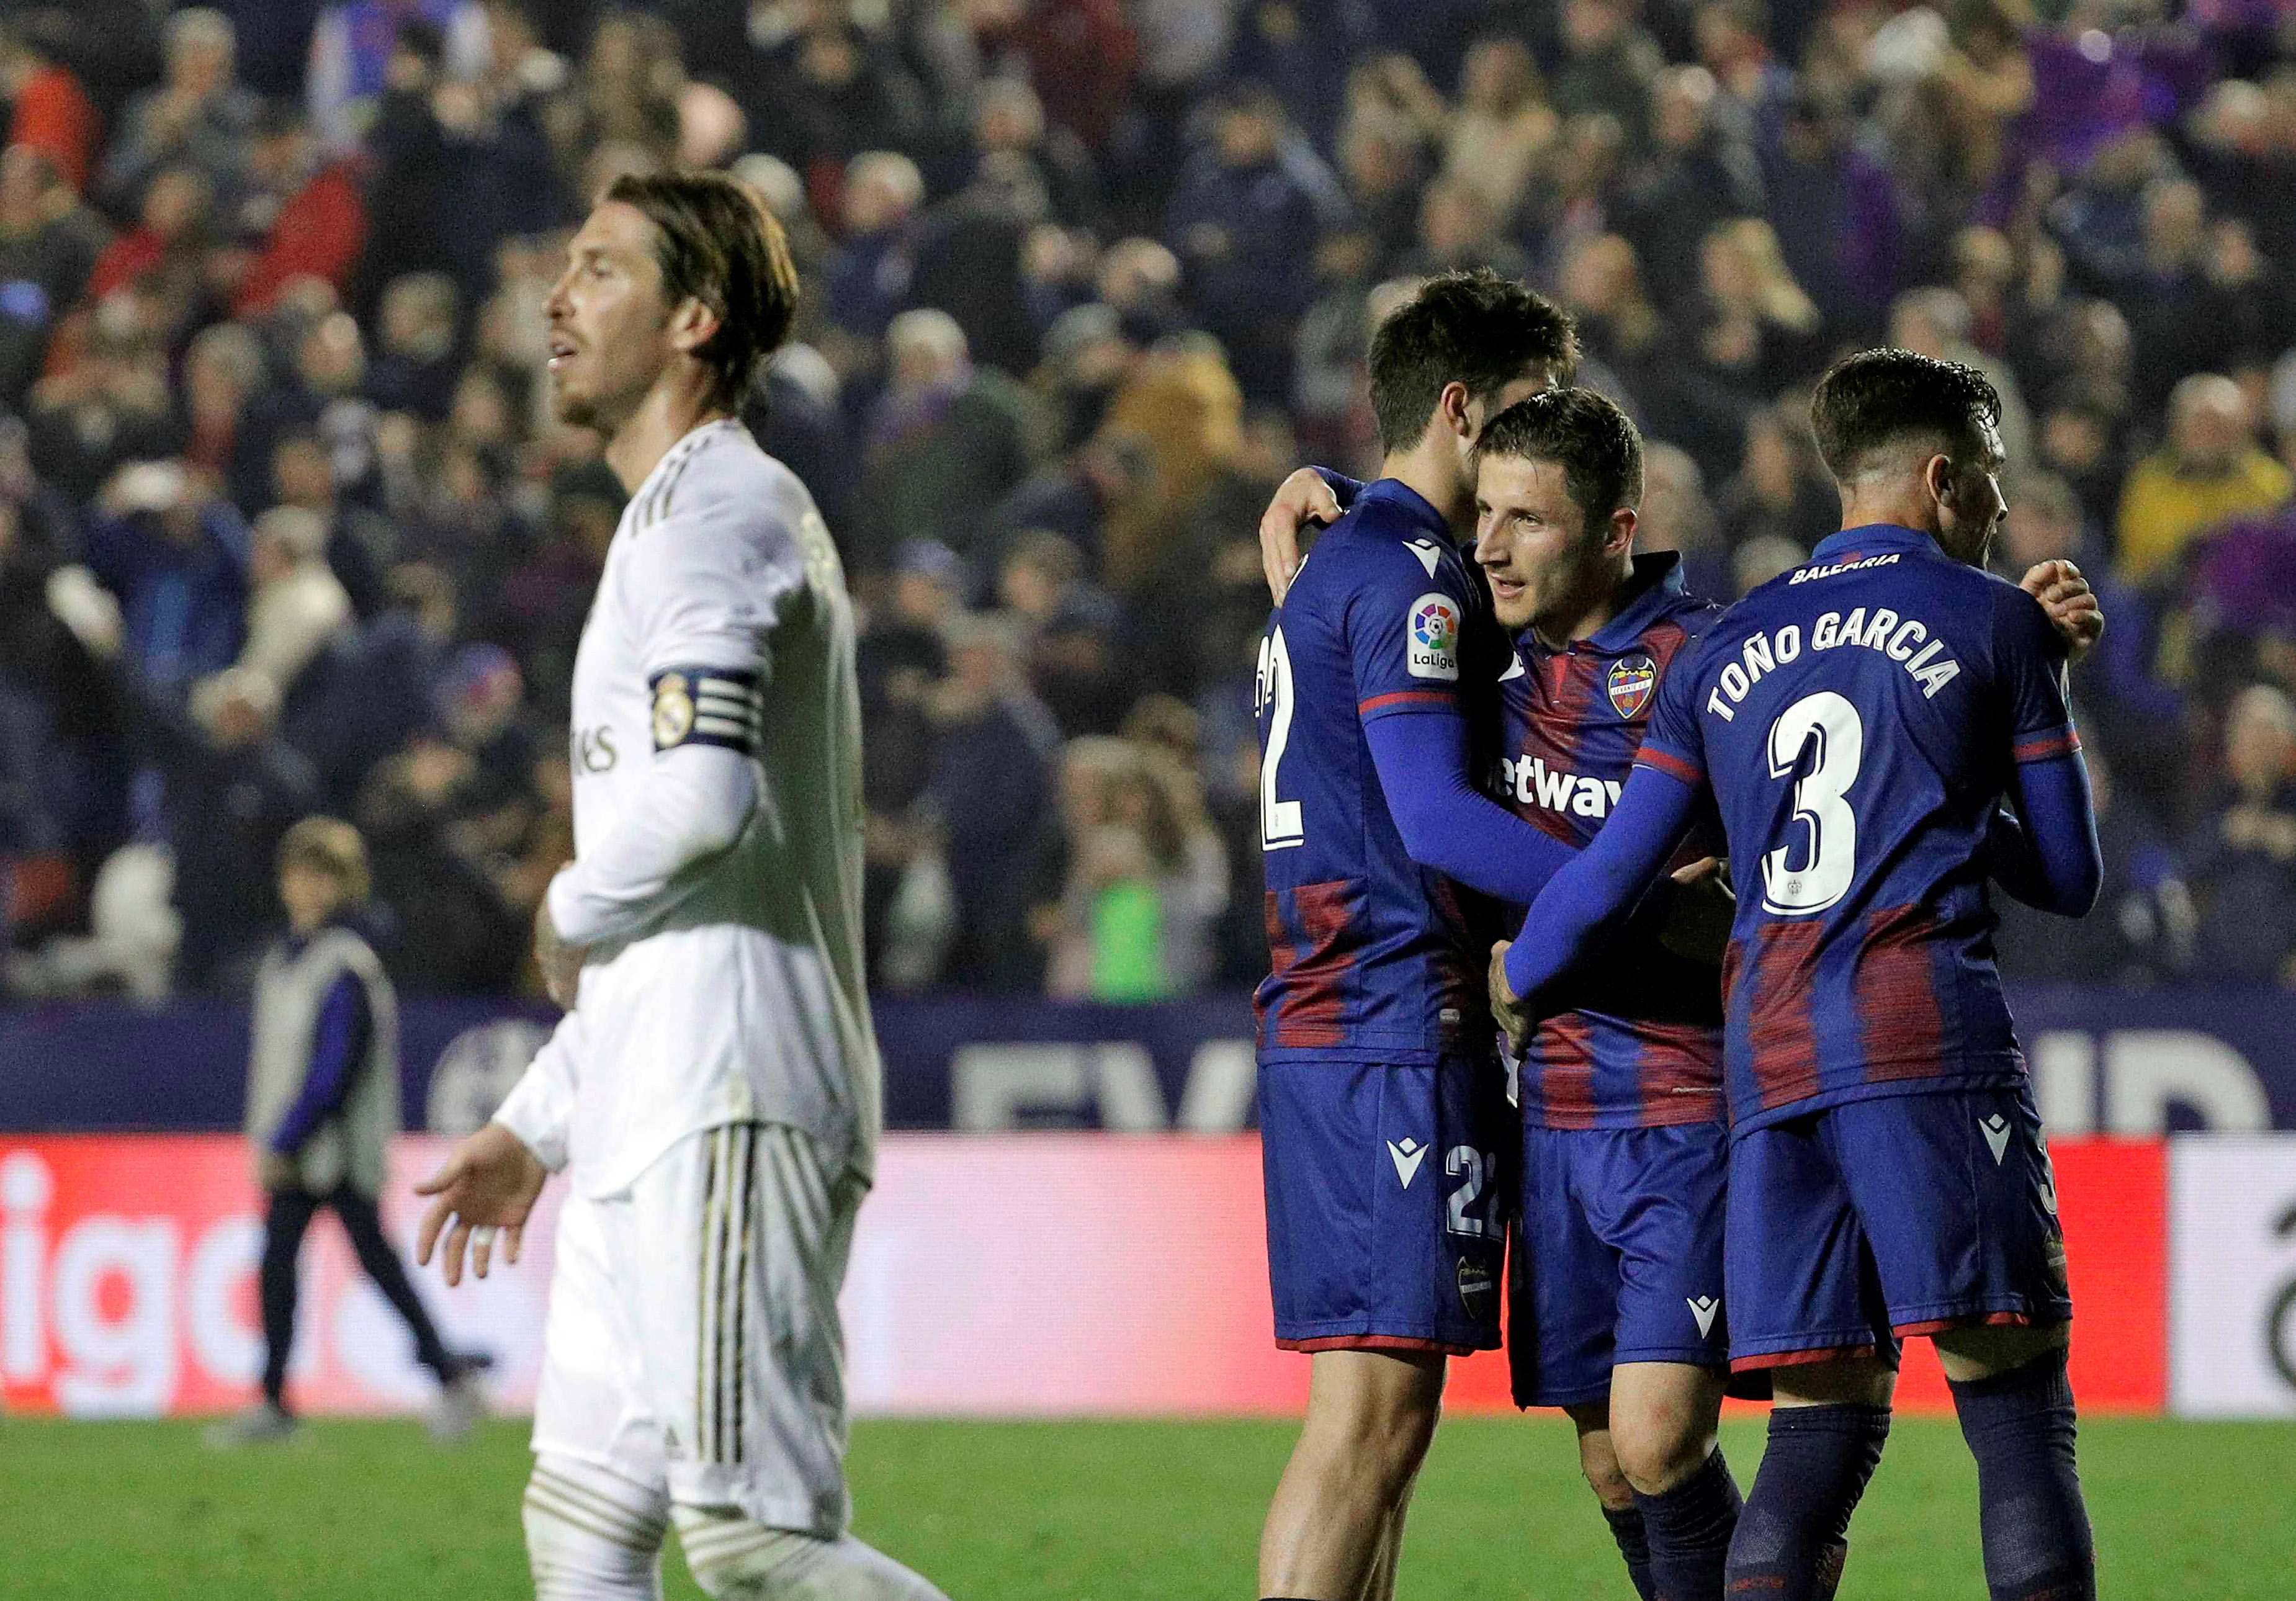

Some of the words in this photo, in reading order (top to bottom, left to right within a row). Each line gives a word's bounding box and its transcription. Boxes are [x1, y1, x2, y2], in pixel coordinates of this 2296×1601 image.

[1414, 652, 1455, 670] LaLiga
[1706, 624, 1800, 722] TOÑO
[1811, 608, 1960, 699] GARCIA
[1761, 690, 1862, 916] 3
